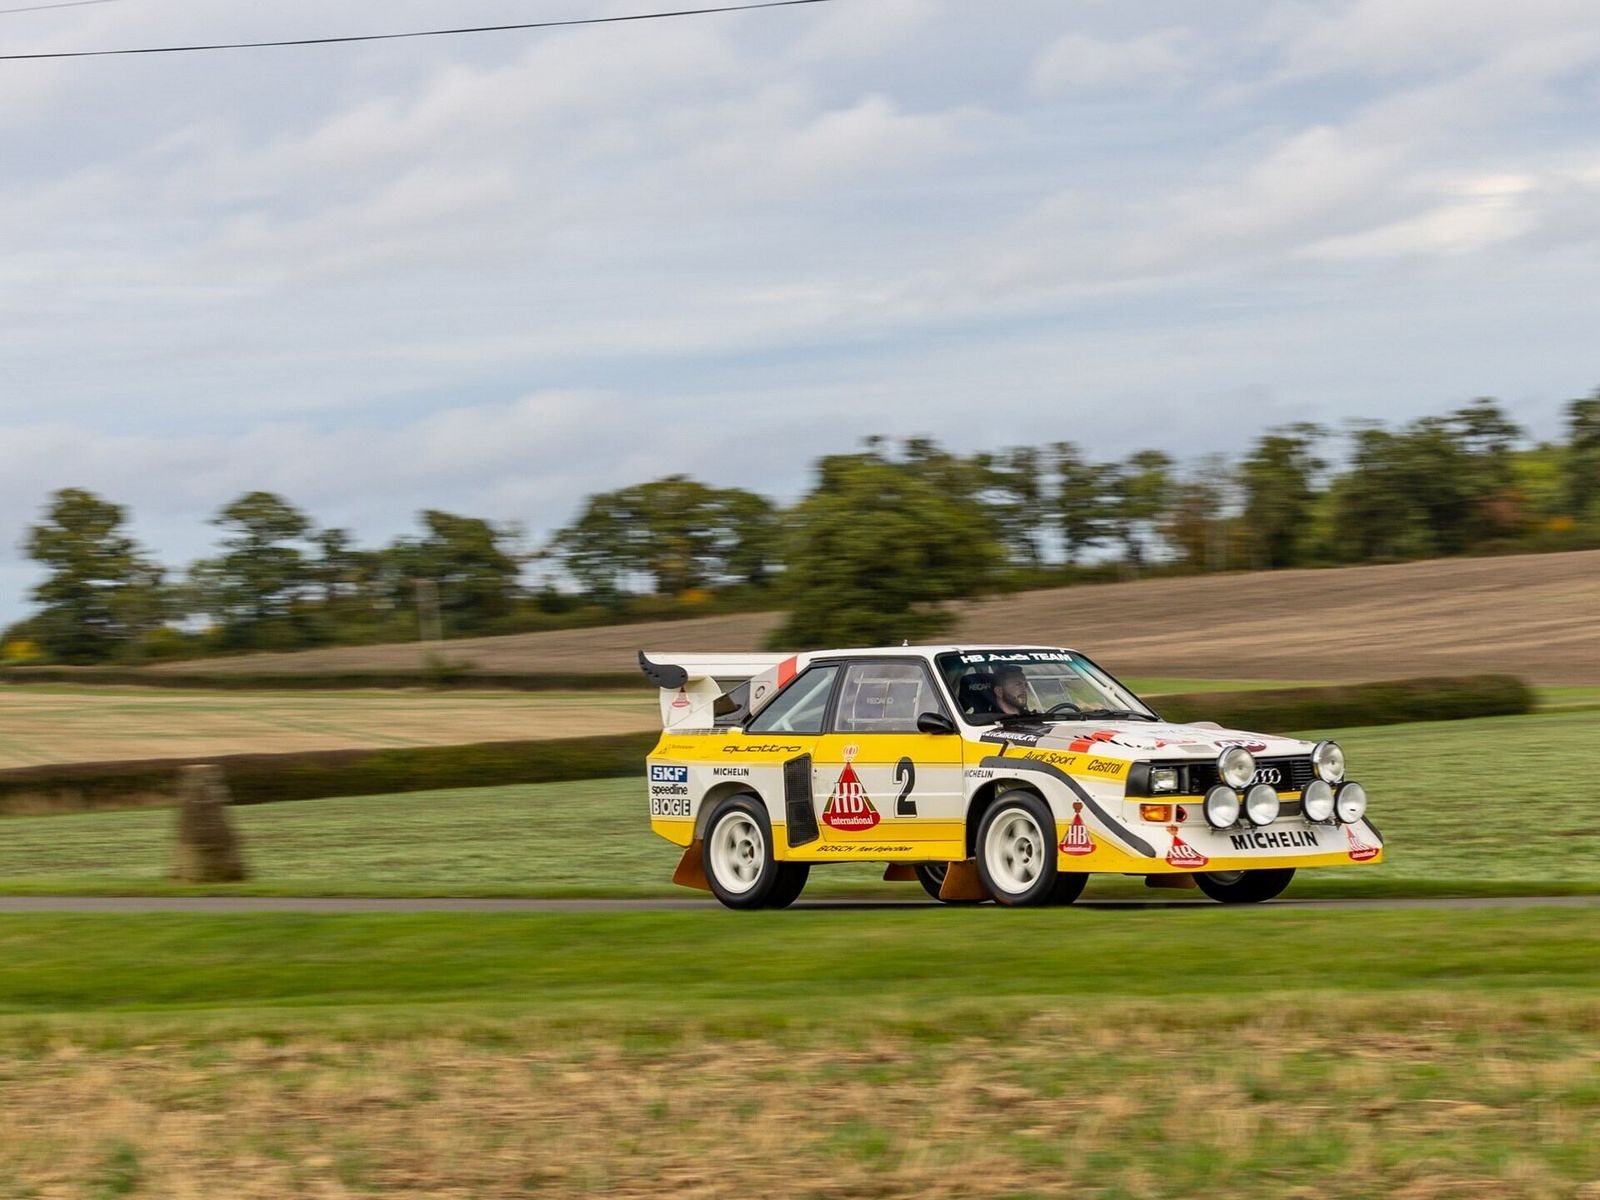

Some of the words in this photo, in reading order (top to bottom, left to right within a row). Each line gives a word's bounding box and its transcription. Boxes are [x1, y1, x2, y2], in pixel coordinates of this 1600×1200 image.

[960, 655, 985, 664] HB
[1029, 653, 1072, 662] TEAM
[722, 745, 802, 754] quattro
[1046, 753, 1077, 766] Sport
[652, 766, 686, 781] SKF
[713, 768, 750, 776] MICHELIN
[1087, 760, 1125, 775] Castrol
[652, 784, 688, 796] speedline
[893, 757, 917, 818] 2
[834, 782, 864, 813] HB
[652, 799, 691, 816] BOGE
[1067, 825, 1088, 845] HB
[1230, 831, 1319, 850] MICHELIN
